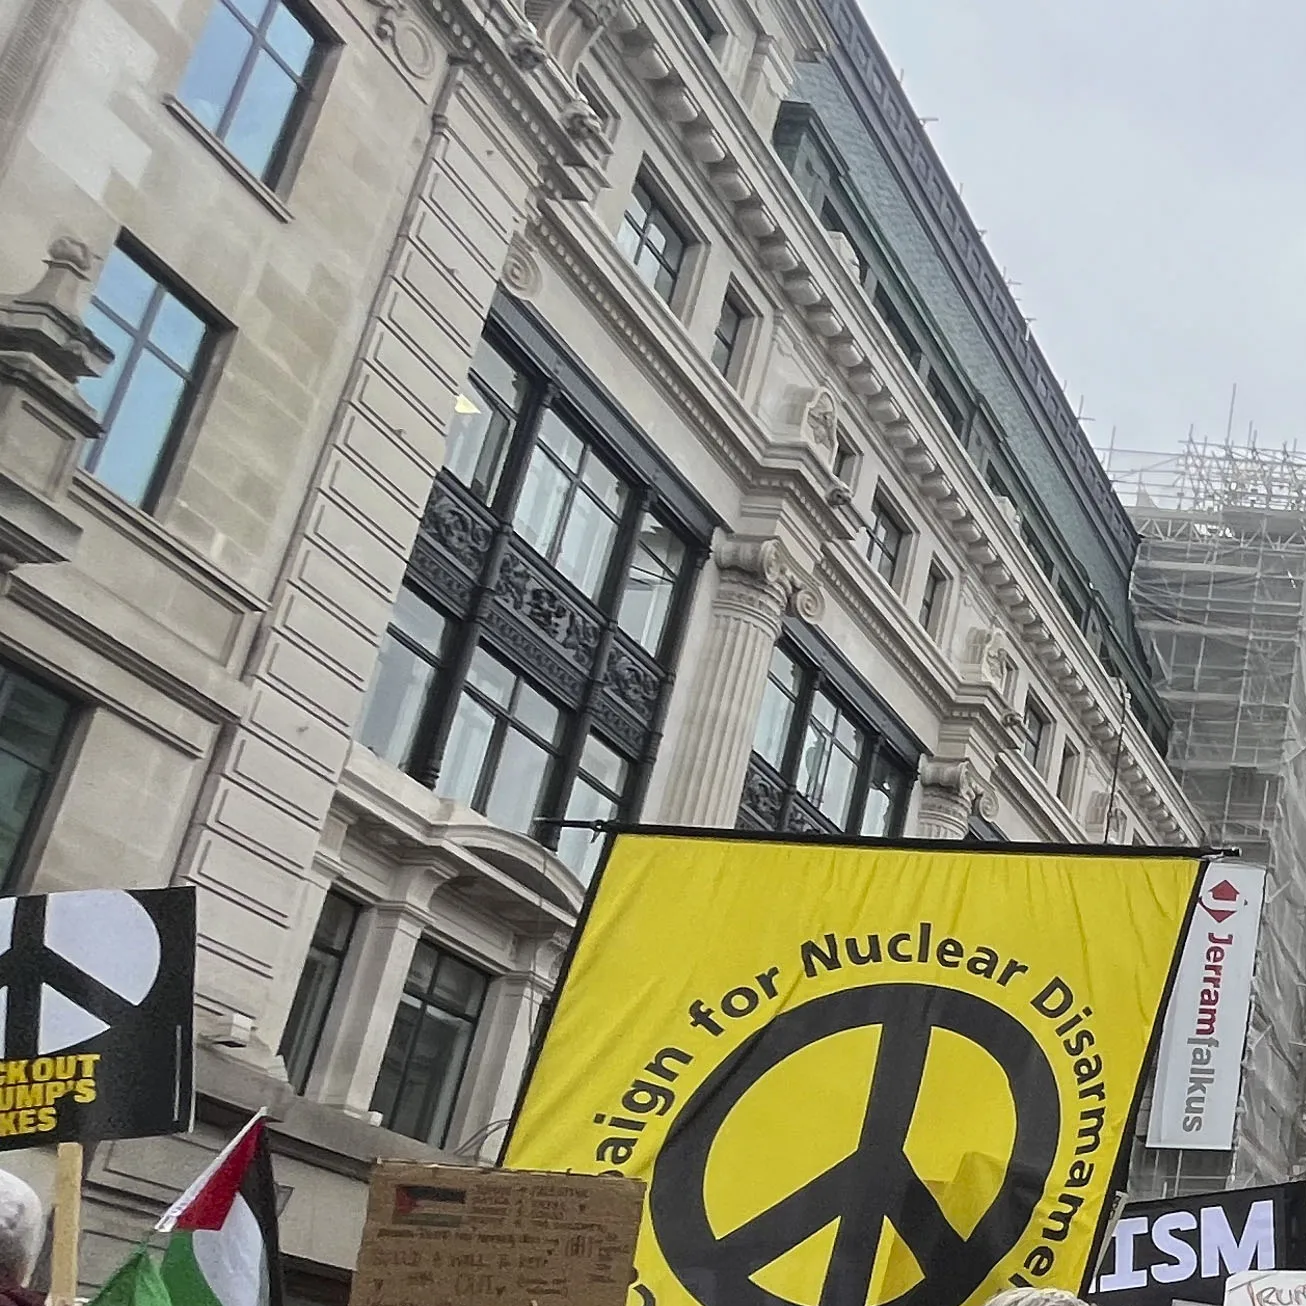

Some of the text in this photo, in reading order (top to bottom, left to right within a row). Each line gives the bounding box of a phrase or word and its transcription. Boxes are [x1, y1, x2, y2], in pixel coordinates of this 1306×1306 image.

[32, 1053, 101, 1082] OUT
[0, 1077, 97, 1111] UMP'S
[688, 966, 781, 1037] for
[800, 921, 1030, 987] Nuclear
[1007, 975, 1108, 1288] Disarmame
[0, 1106, 57, 1136] KES
